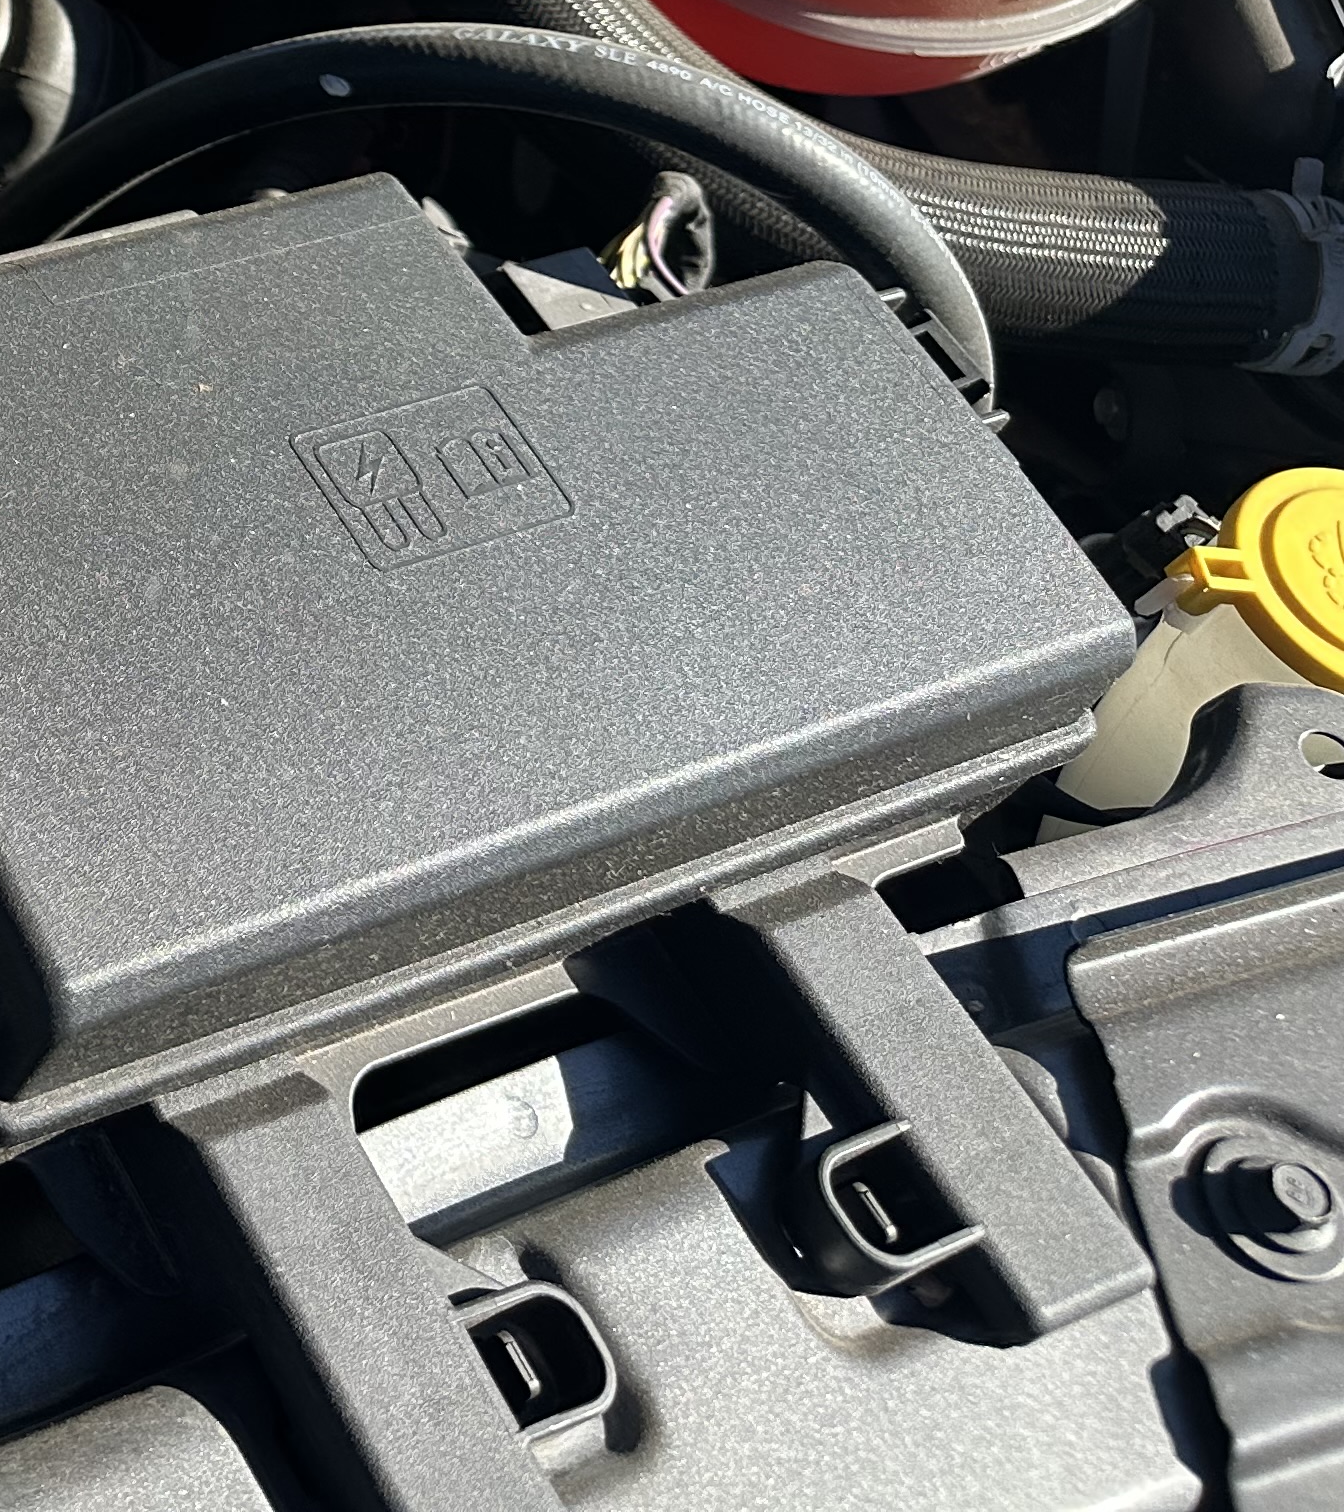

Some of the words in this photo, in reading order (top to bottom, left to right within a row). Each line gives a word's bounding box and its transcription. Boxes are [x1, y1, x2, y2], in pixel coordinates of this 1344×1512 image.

[451, 27, 589, 54] GALAXY
[594, 45, 638, 67] SLE
[646, 59, 693, 81] 4890
[700, 77, 734, 98] A/C
[738, 90, 790, 125] HOSE
[794, 120, 838, 154] 13/32
